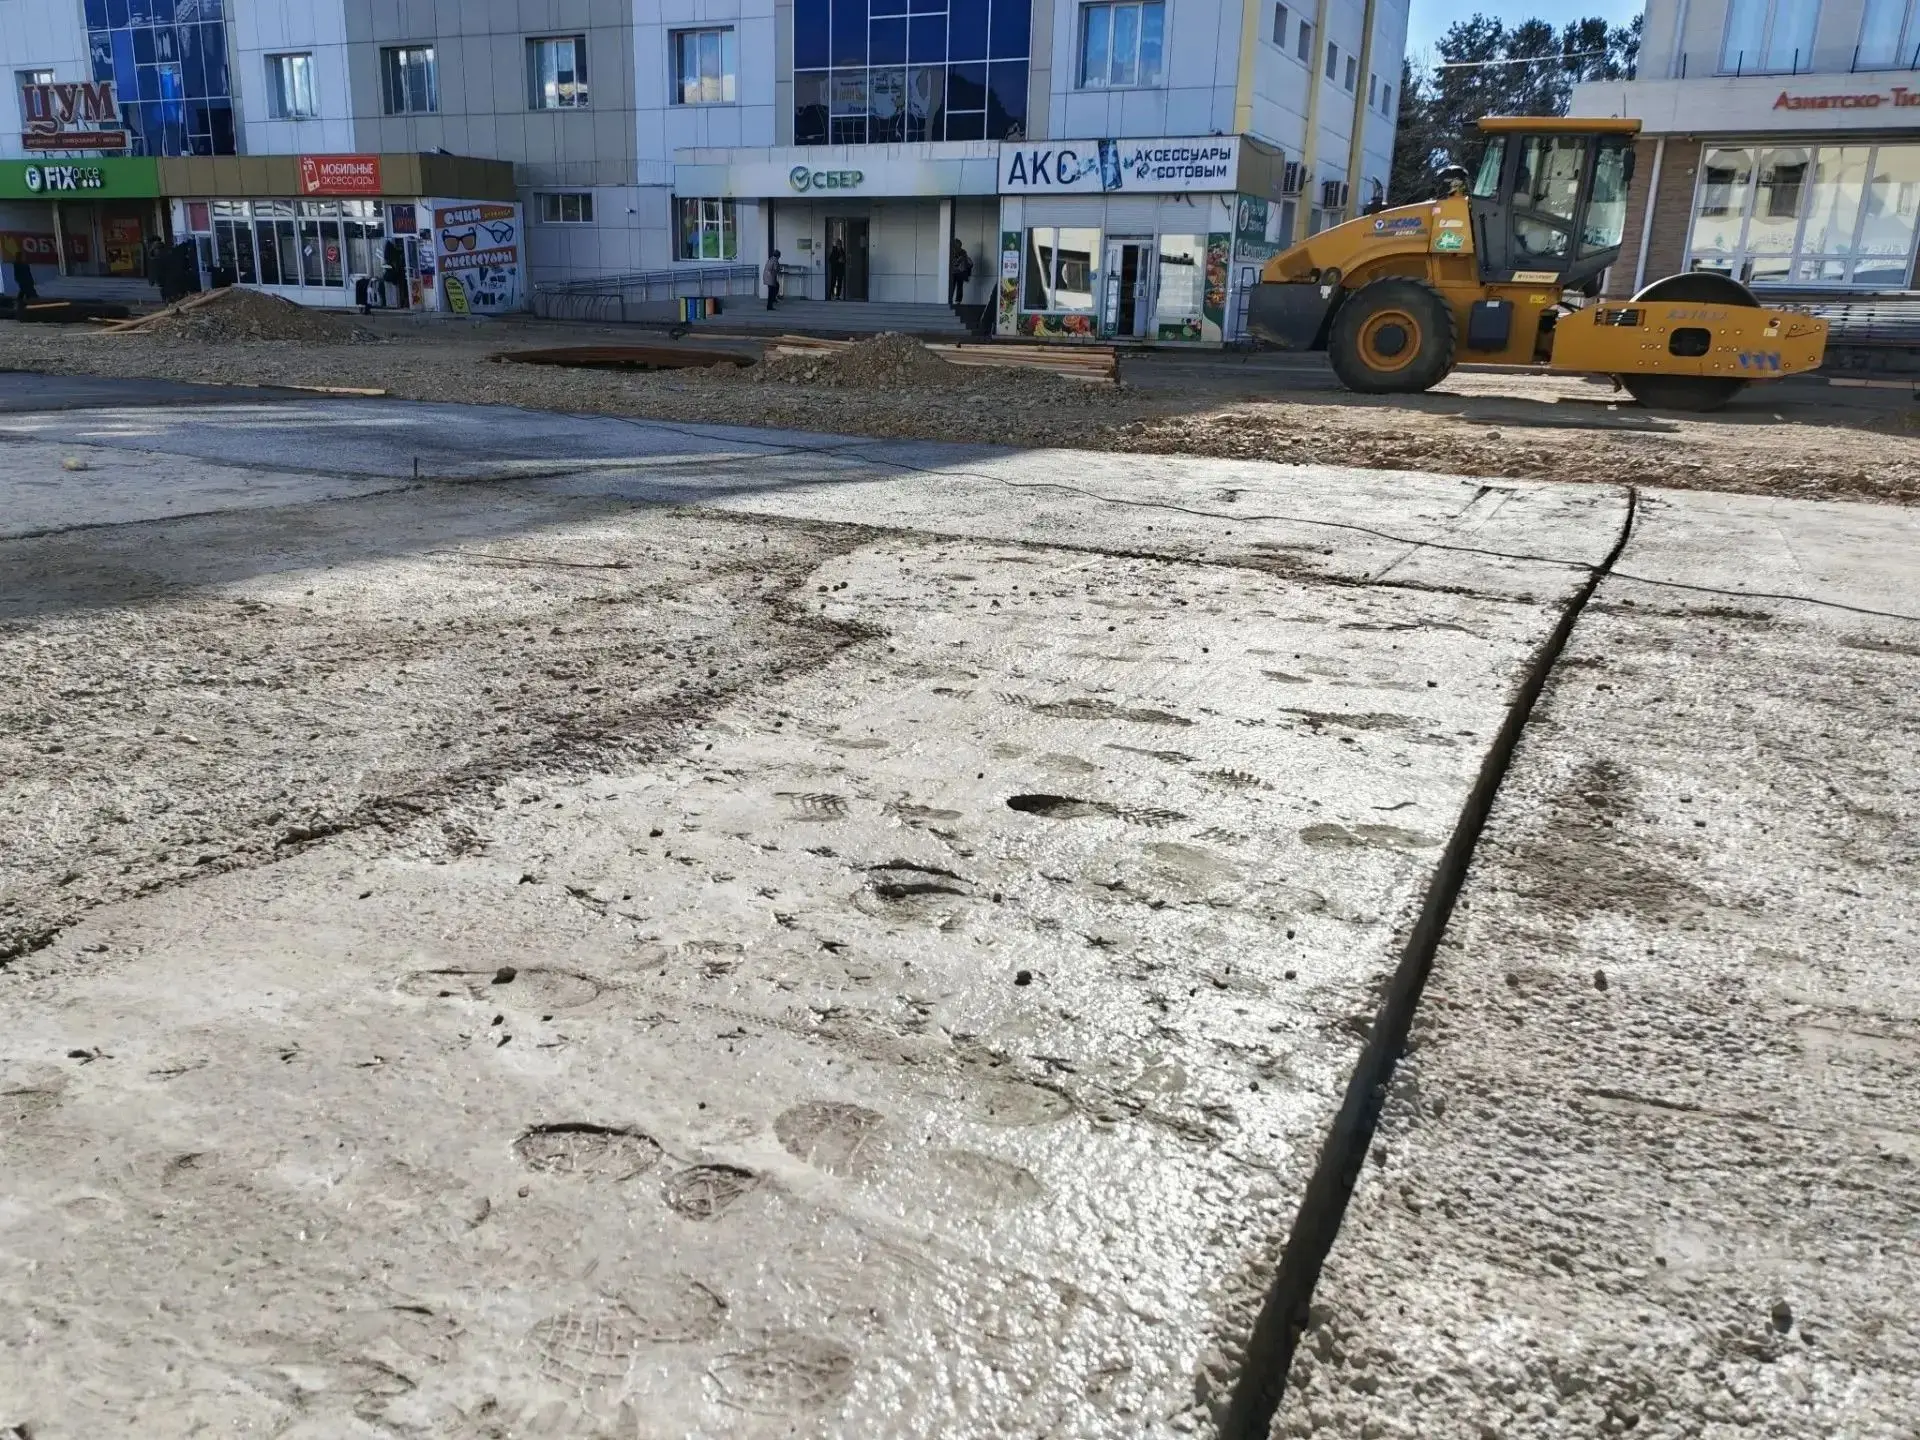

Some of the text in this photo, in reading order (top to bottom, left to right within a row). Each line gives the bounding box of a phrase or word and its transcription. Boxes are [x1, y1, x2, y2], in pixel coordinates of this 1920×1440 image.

[24, 82, 119, 134] ЦУМ
[1134, 147, 1231, 163] АКСЕССУАРЫ
[321, 163, 374, 175] МОБИЛЬНЫЕ
[1008, 150, 1077, 186] АКС
[1156, 165, 1227, 180] СОТОВЫМ
[321, 176, 375, 188] аксессуары
[812, 170, 864, 190] СБЕР
[444, 208, 480, 225] ОЧКИ
[444, 251, 513, 268] АКСЕССУАРЫ
